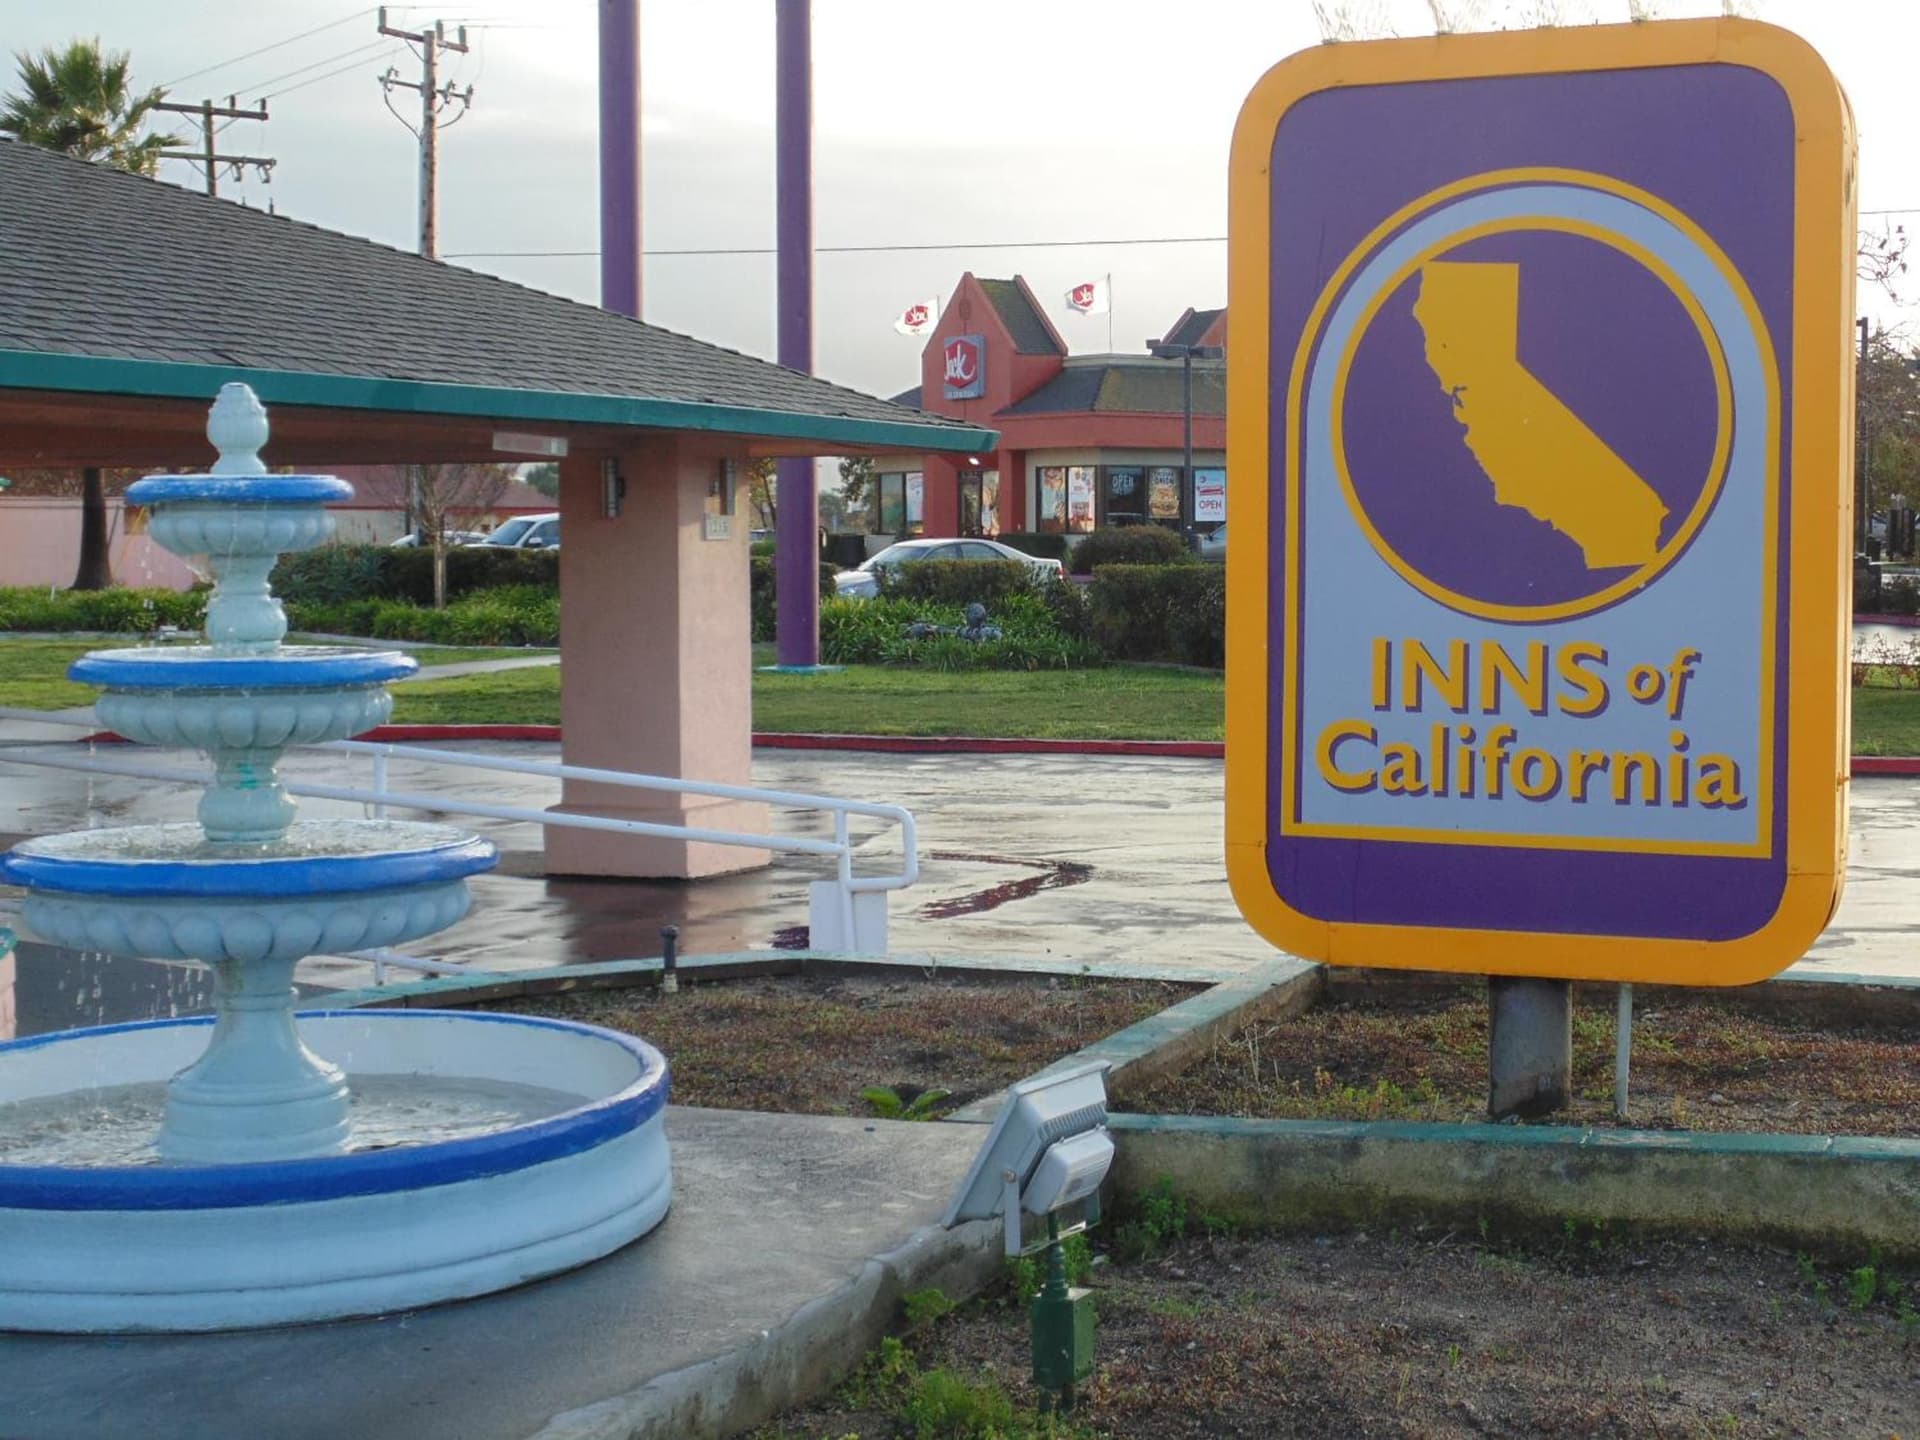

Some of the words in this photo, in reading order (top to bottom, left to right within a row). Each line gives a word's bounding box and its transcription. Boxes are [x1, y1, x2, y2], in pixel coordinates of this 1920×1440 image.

[1112, 475, 1134, 489] OPEN
[1199, 500, 1222, 510] OPEN
[1372, 637, 1609, 718] INNS
[1626, 647, 1702, 720] of
[1315, 718, 1748, 811] California
